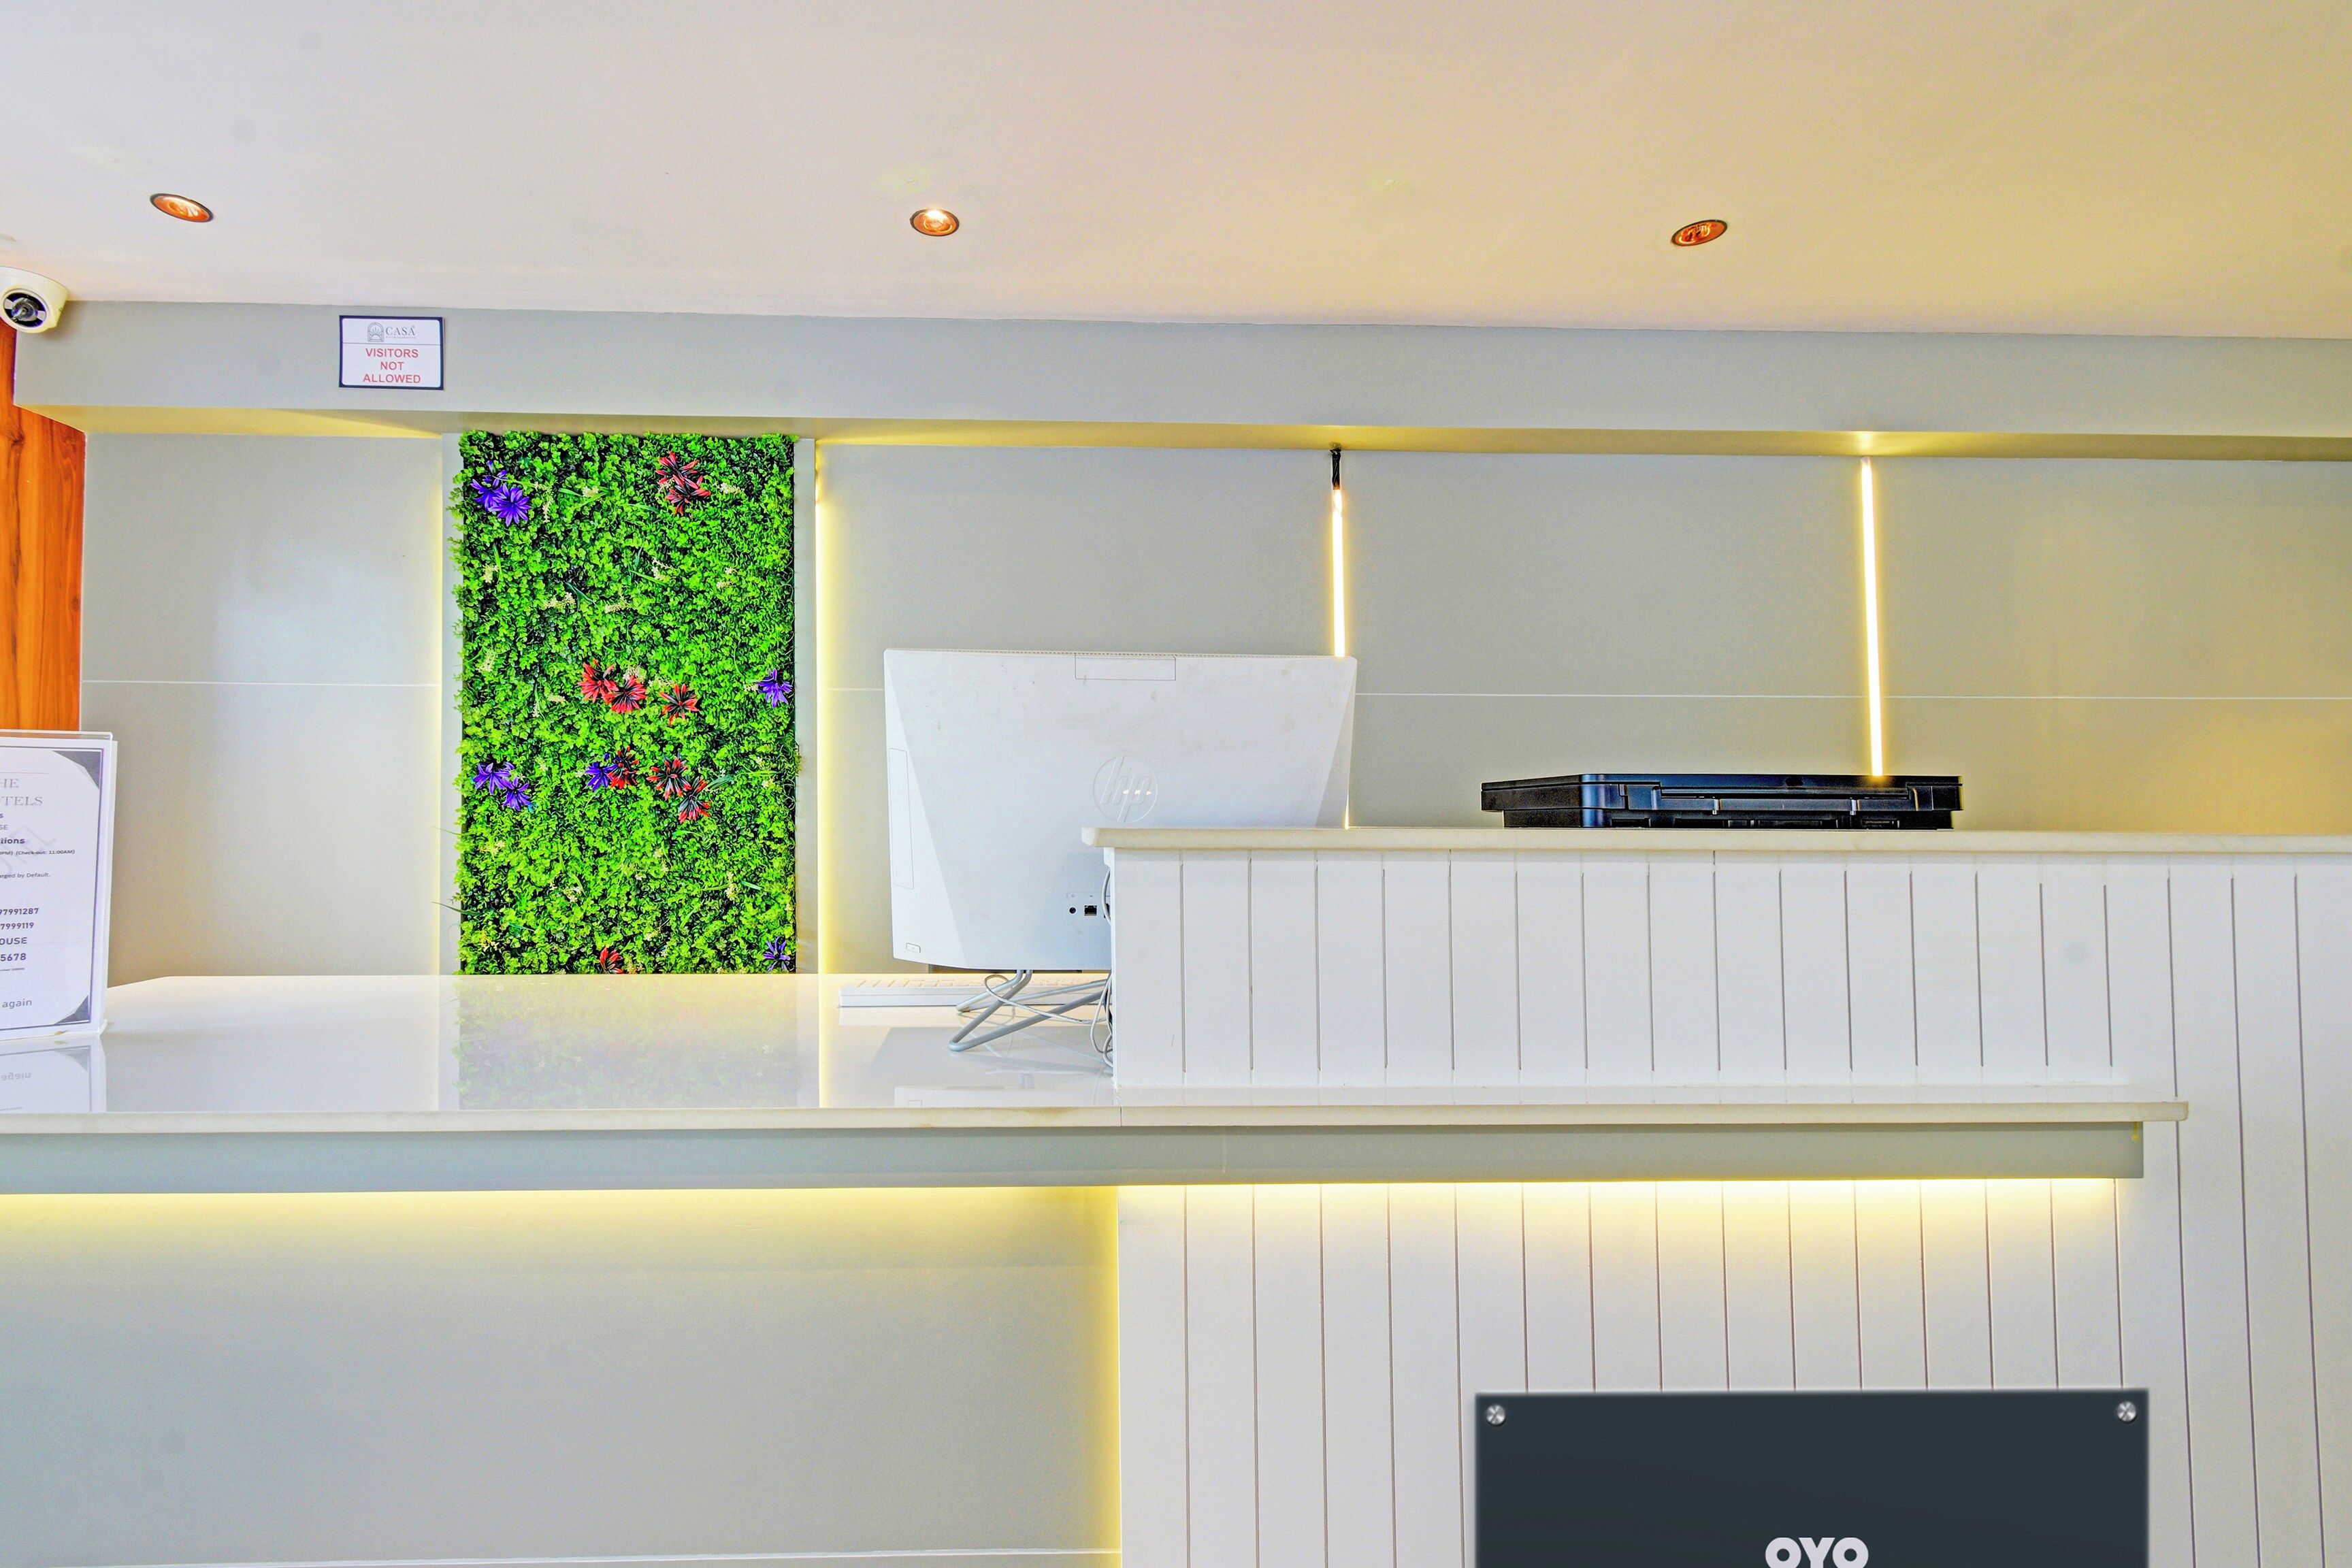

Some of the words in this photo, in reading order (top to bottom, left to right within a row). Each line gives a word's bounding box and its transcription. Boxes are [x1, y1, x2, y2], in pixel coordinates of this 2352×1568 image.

[385, 327, 415, 336] CASA
[365, 348, 419, 358] VISITORS
[380, 362, 404, 370] NOT
[363, 374, 421, 383] ALLOWED
[1100, 756, 1152, 822] hp
[1, 796, 43, 806] TELS
[0, 937, 27, 945] OUSE
[1, 953, 26, 962] 5678
[2, 998, 33, 1009] again
[1765, 1537, 1869, 1568] OYO
